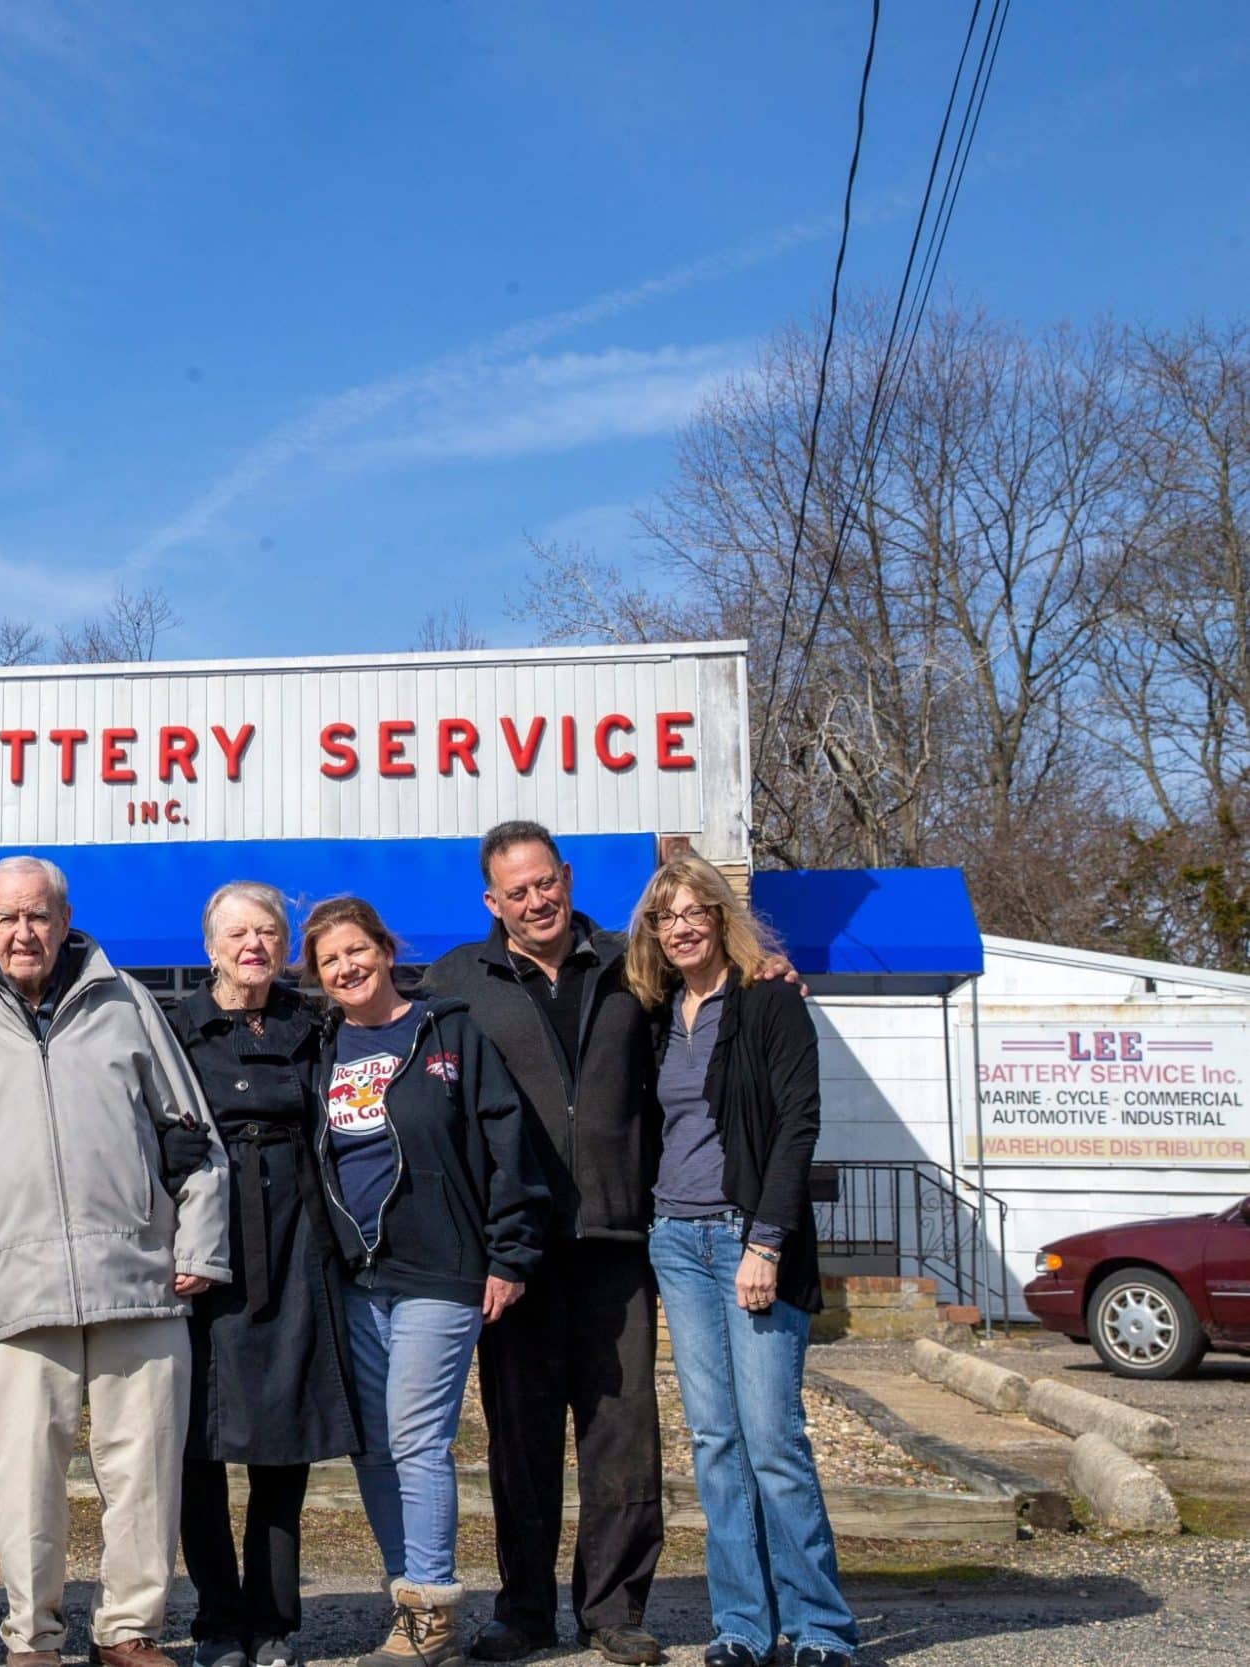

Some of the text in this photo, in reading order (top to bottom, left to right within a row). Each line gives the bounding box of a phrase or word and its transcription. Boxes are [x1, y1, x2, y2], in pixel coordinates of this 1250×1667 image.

[320, 712, 696, 778] SERVICE
[1068, 1031, 1143, 1061] LEE
[976, 1064, 1243, 1084] BATTERY SERVICE Inc.
[979, 1090, 1042, 1105] MARINE
[1056, 1090, 1110, 1106] CYCLE
[1124, 1091, 1244, 1107] COMMERCIAL
[992, 1109, 1107, 1125] AUTOMOTIVE
[1121, 1110, 1226, 1126] INDUSTRIAL
[981, 1138, 1247, 1158] WAREHOUSE DISTRIBUTOR
